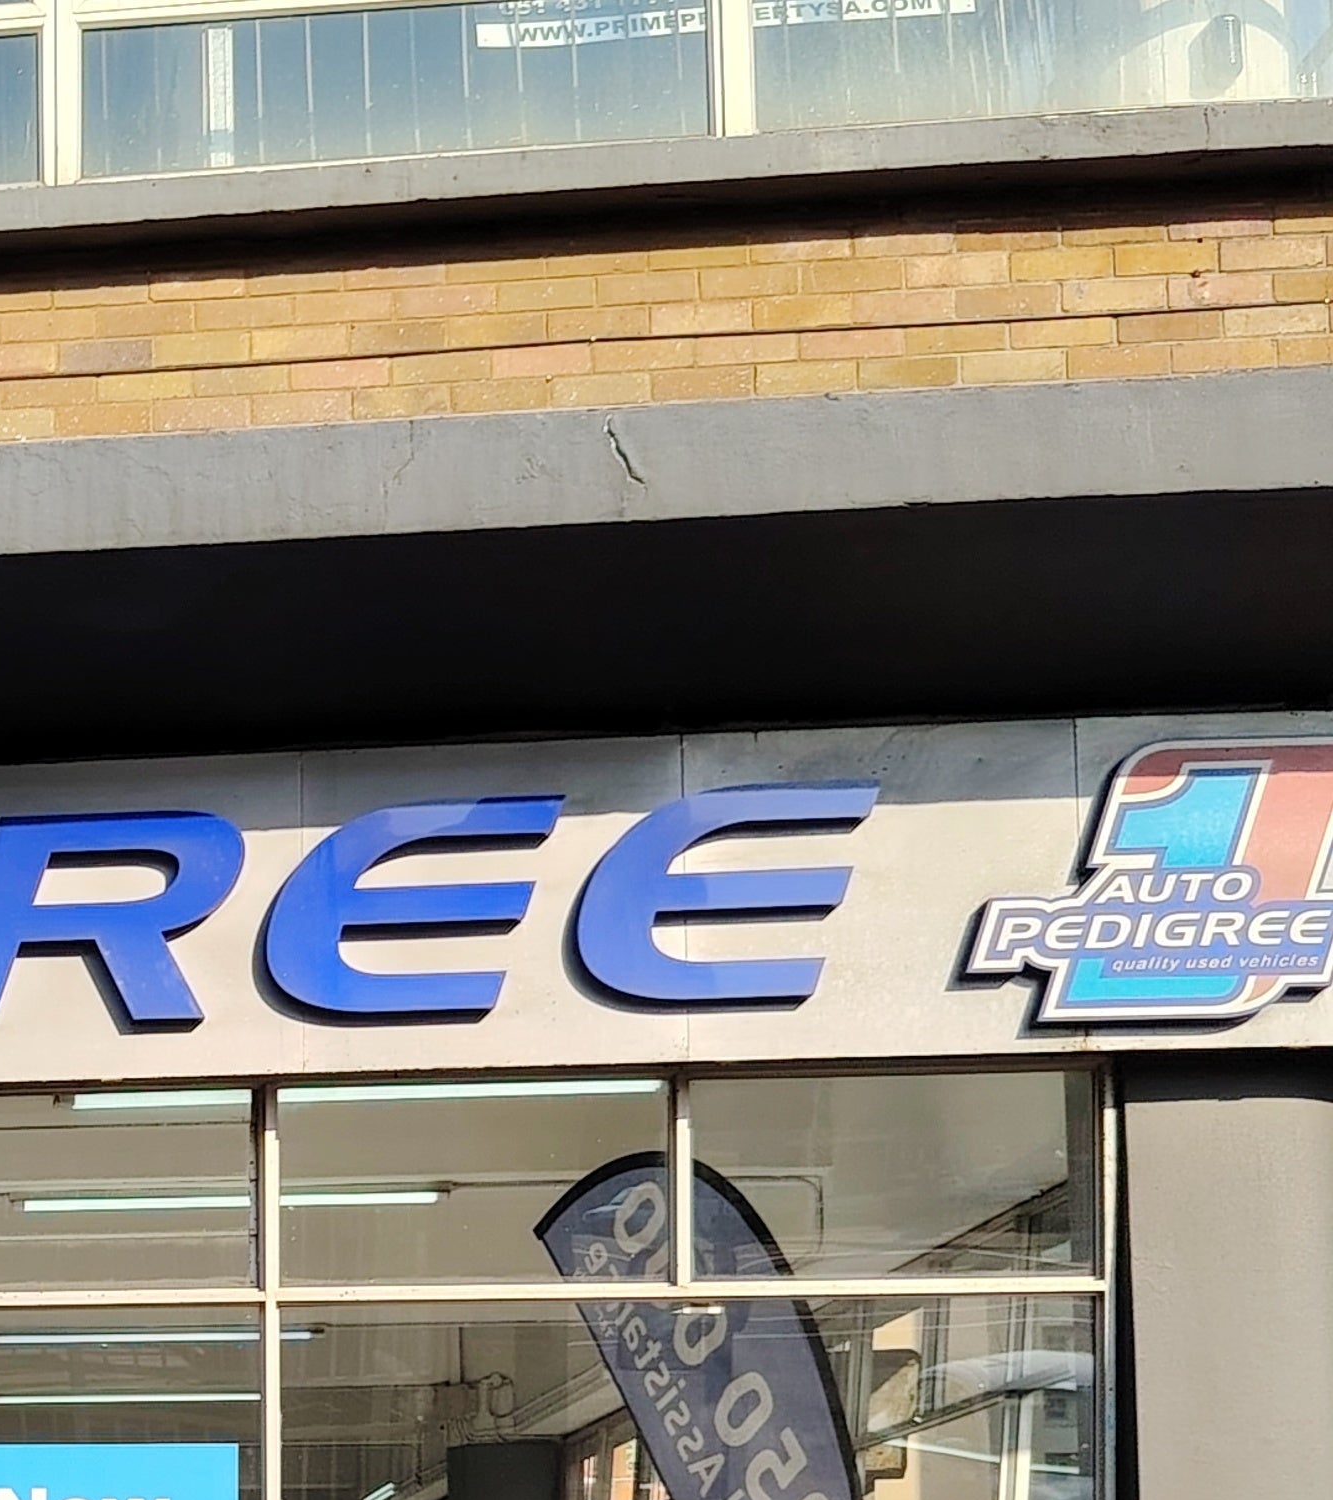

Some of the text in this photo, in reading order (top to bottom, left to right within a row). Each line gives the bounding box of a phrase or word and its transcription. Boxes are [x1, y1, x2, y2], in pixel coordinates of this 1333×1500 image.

[1097, 870, 1253, 904] AUTO
[995, 910, 1332, 951] PEDIGREE
[1112, 953, 1319, 972] quality used vehicles
